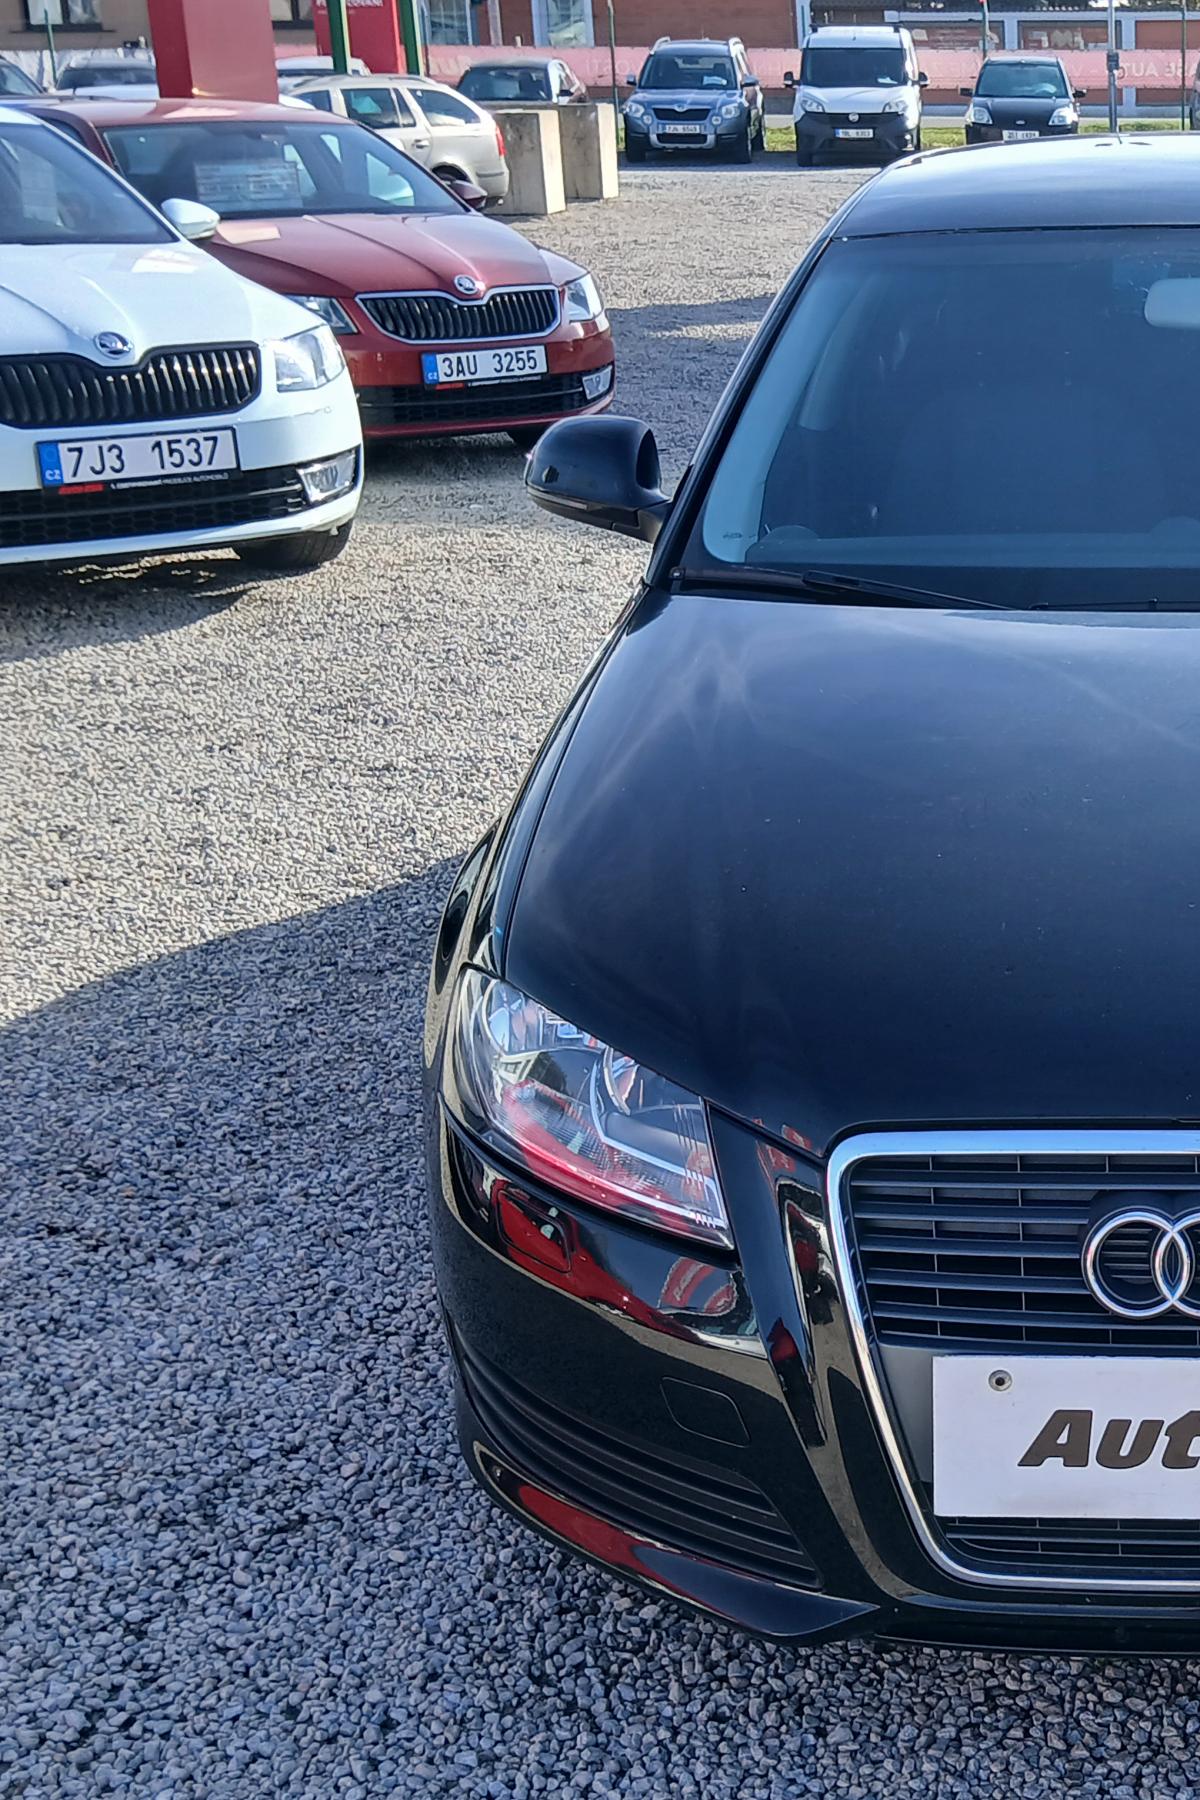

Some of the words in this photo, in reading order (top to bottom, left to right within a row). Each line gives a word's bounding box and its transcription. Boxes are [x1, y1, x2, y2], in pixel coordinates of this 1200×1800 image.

[442, 354, 478, 378] 3AU
[492, 349, 538, 374] 3255
[67, 443, 125, 478] 7J3
[151, 435, 218, 470] 1537
